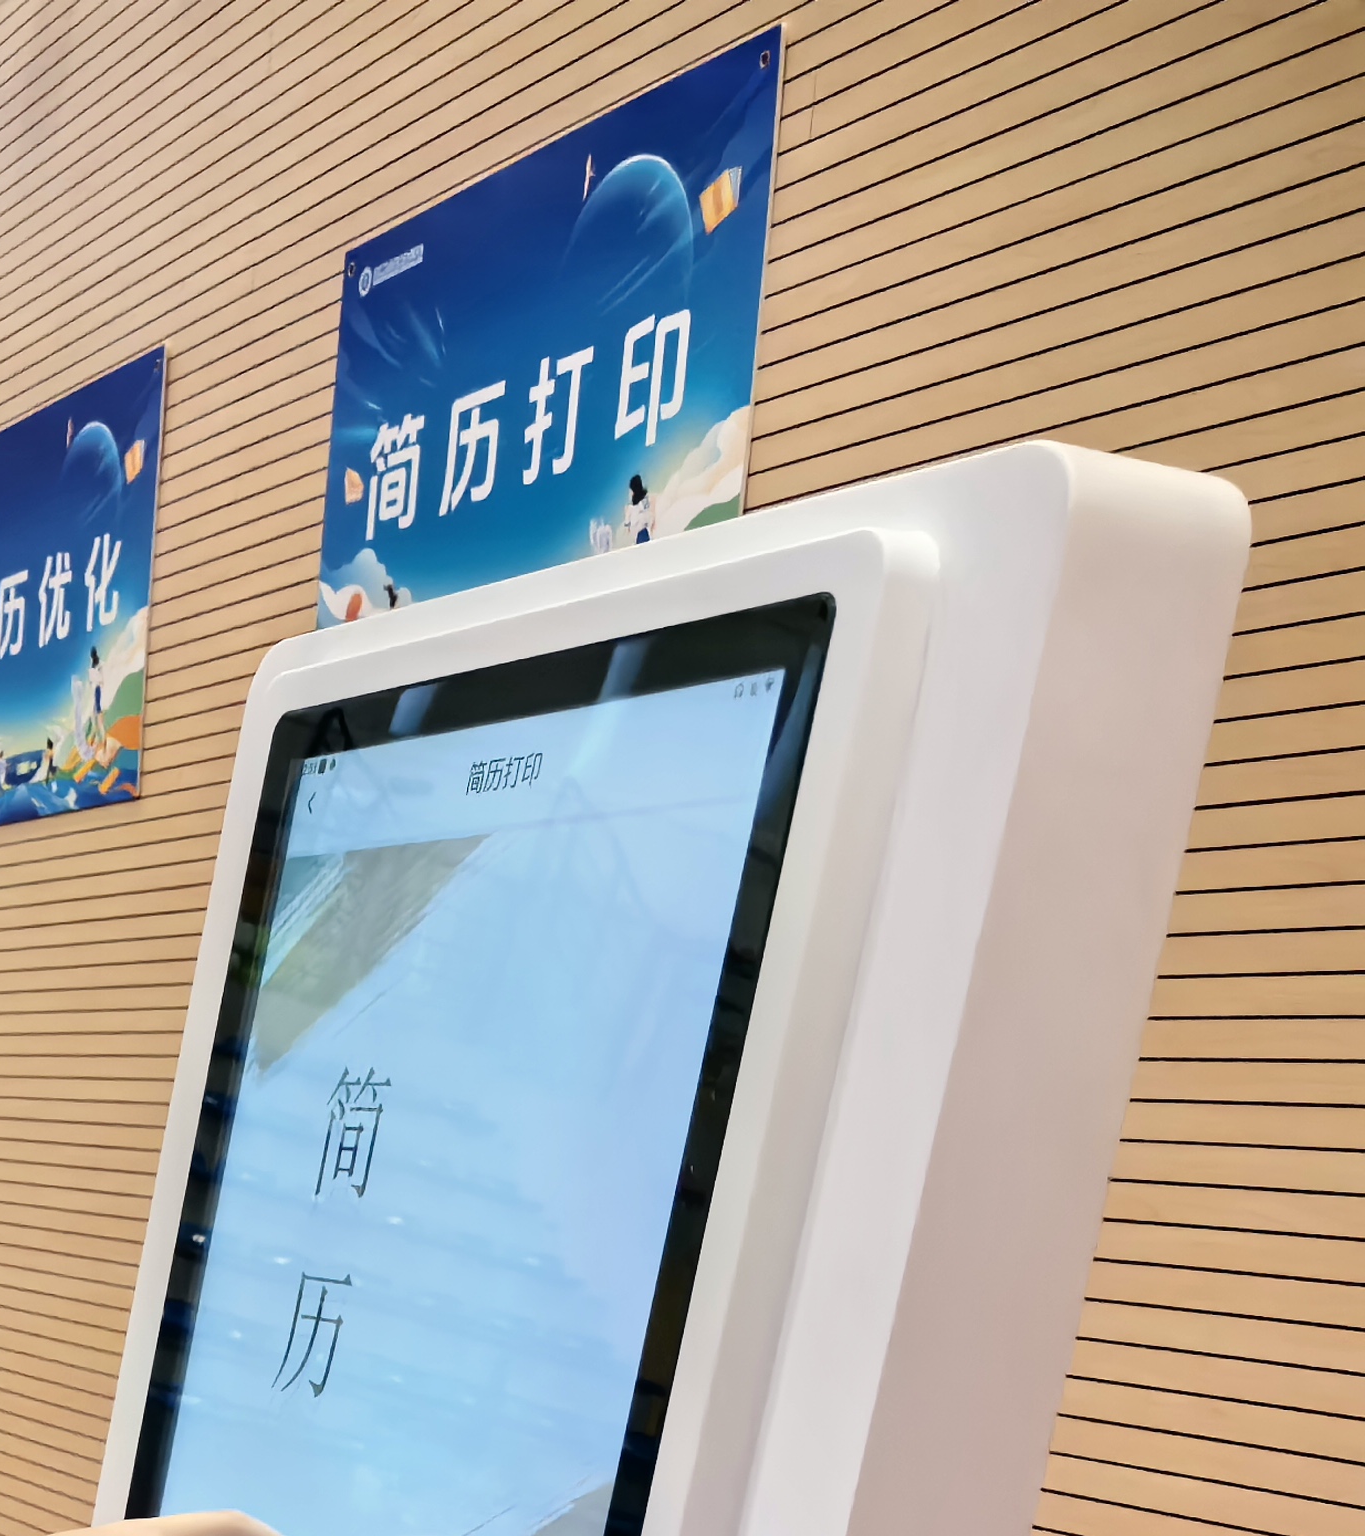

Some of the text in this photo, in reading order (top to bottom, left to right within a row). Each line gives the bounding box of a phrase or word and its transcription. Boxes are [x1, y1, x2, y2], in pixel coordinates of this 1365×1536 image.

[365, 309, 692, 541] 简历打印
[466, 753, 543, 795] 简历打印
